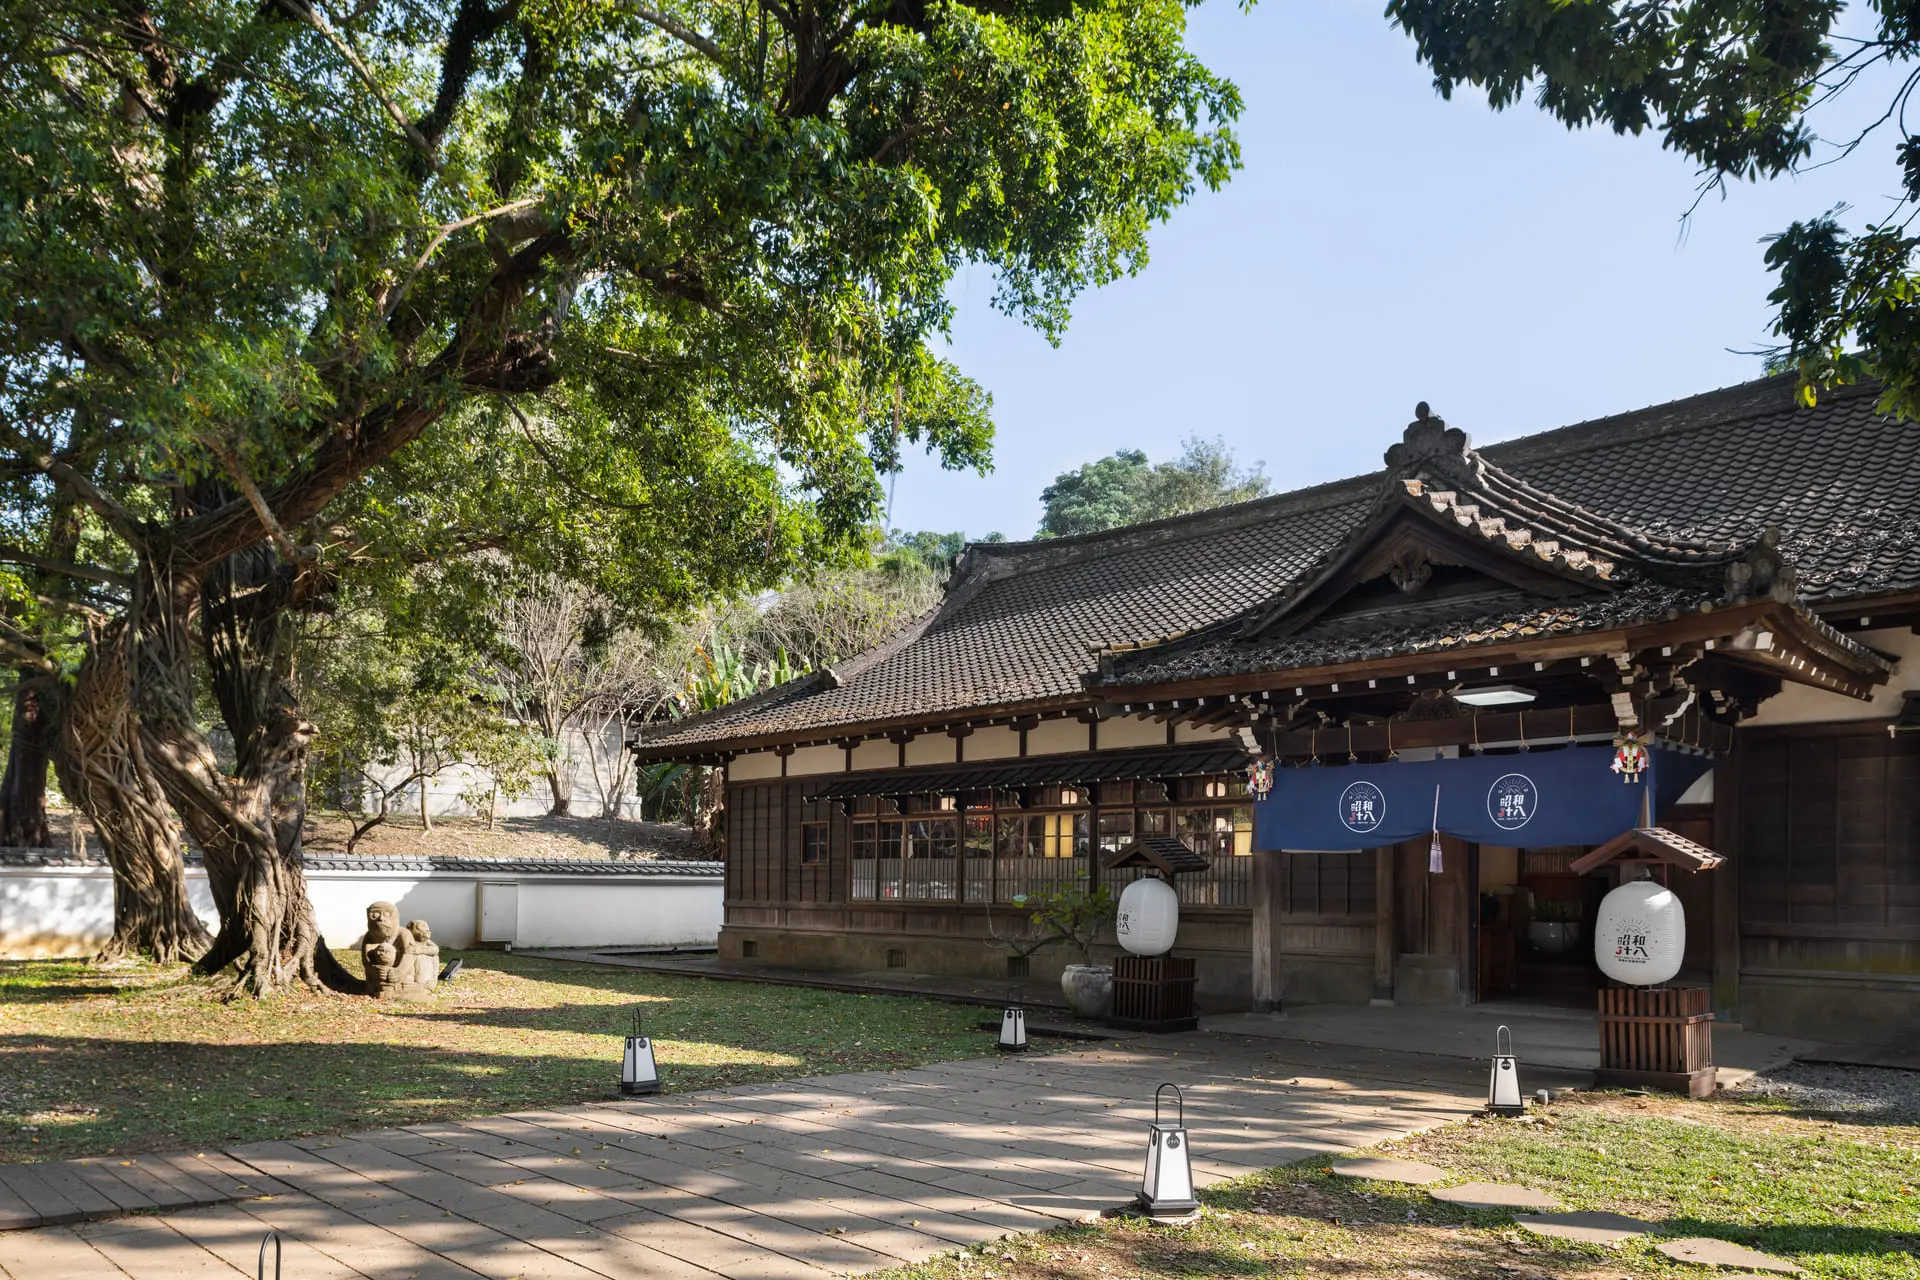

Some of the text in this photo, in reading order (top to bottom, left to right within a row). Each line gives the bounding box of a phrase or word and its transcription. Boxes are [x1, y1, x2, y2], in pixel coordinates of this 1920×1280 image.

[1350, 800, 1373, 812] 昭和
[1500, 794, 1524, 807] 昭和
[1617, 934, 1646, 946] 昭和
